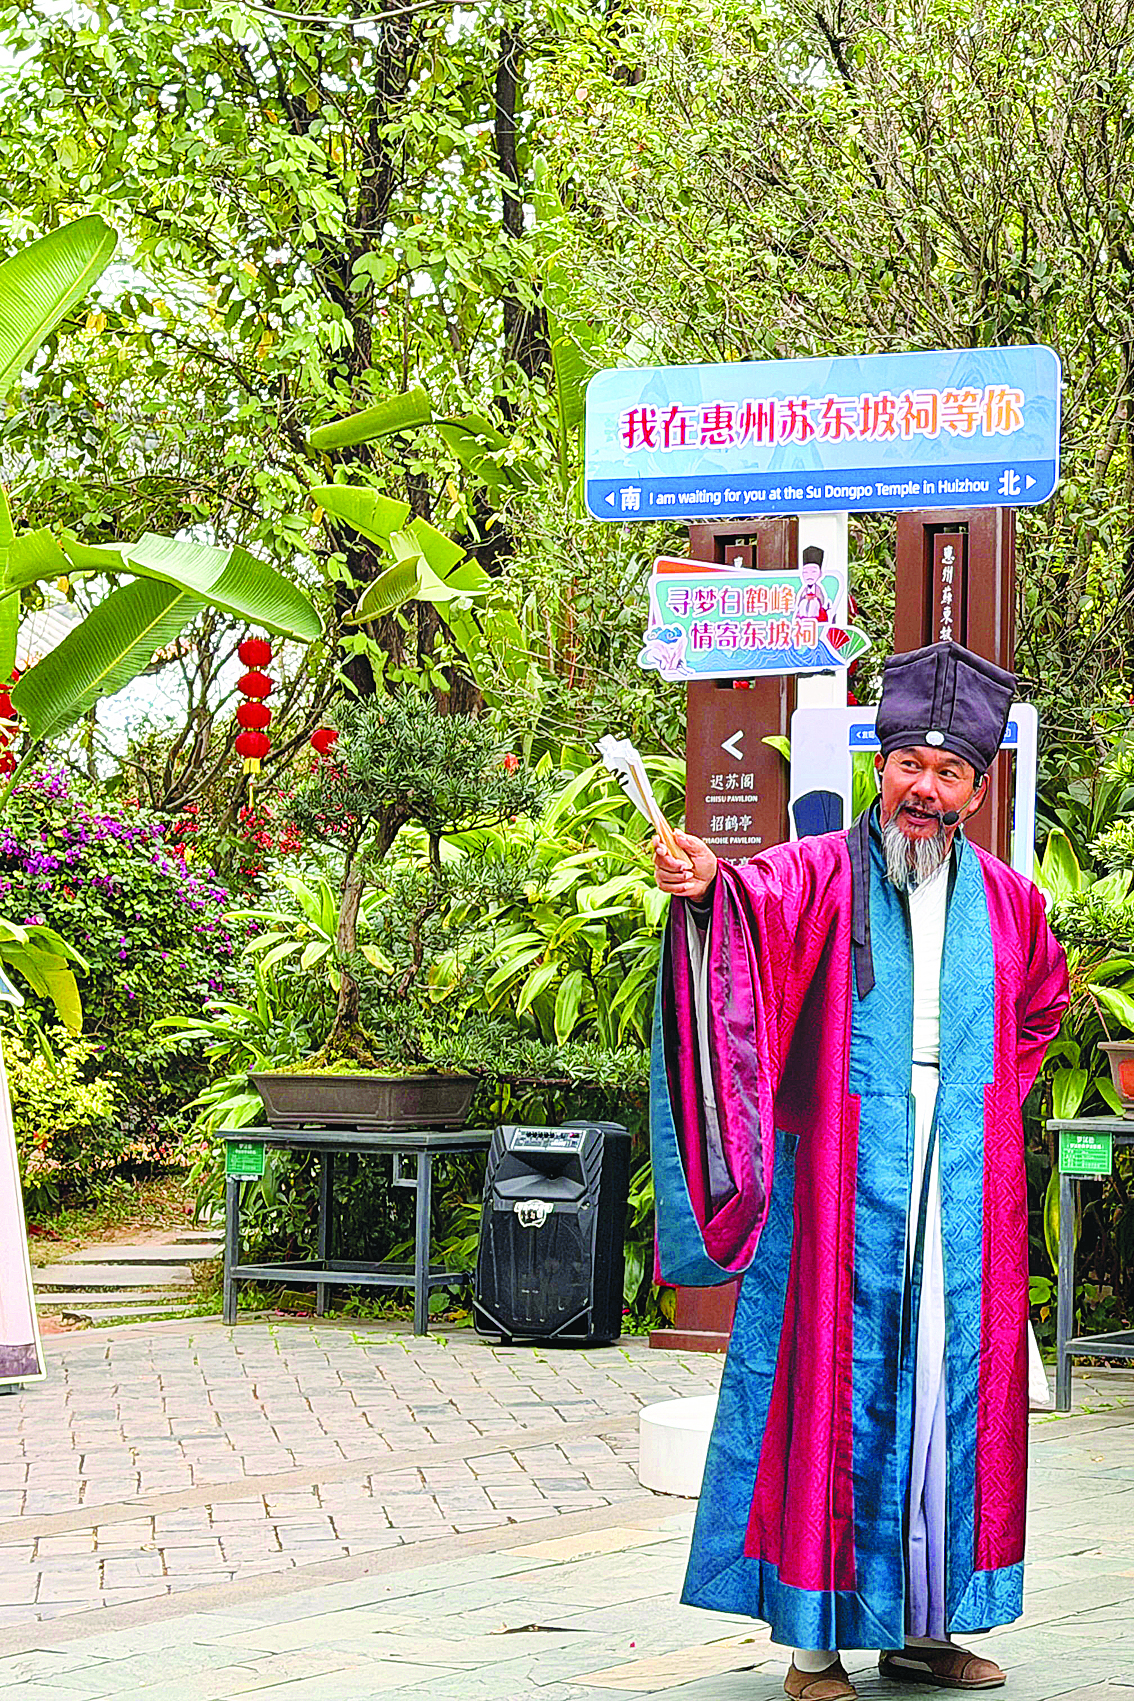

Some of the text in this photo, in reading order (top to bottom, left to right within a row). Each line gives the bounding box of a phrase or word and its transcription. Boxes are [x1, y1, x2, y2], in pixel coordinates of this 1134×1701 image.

[621, 387, 1024, 450] 我在惠州苏东坡祠等你
[649, 478, 990, 507] I am waiting for you at the Su Dongpo Temple in Huizhou
[998, 469, 1021, 496] 北
[620, 485, 642, 511] 南
[667, 585, 796, 617] 寻梦白鹤峰
[690, 620, 818, 650] 情寄东坡祠
[710, 773, 754, 791] 迟苏阁
[727, 795, 759, 803] PAVILION
[710, 814, 753, 832] 招鹤亭
[730, 836, 762, 844] PAVILION
